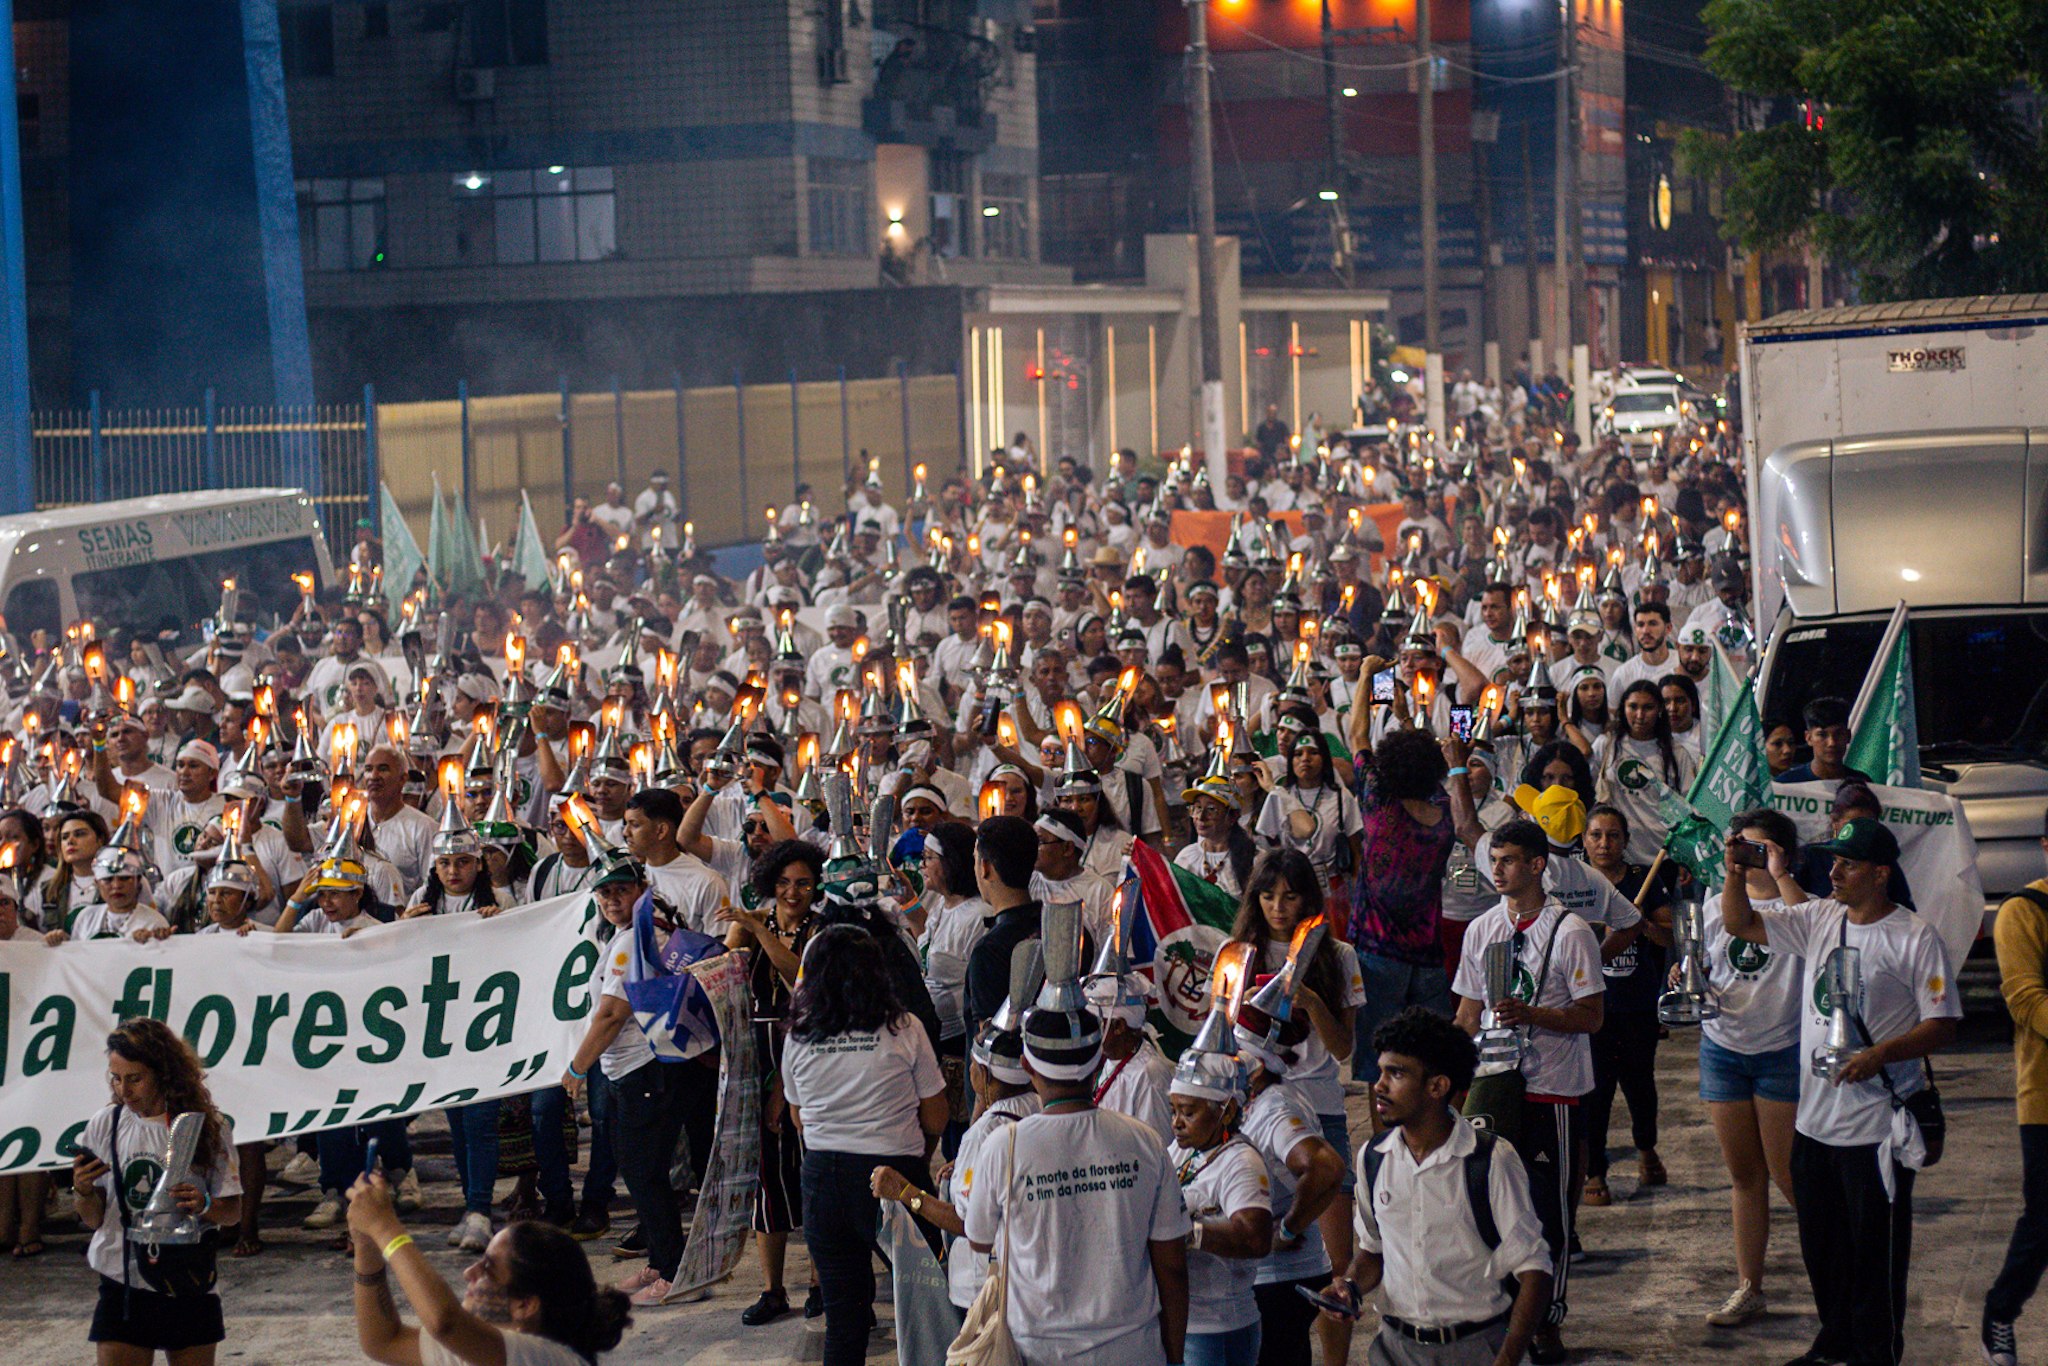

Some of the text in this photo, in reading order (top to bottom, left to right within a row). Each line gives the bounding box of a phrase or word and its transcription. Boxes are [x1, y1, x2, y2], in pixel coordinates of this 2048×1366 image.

[1890, 350, 1961, 362] THORCK
[78, 520, 153, 554] SEMAS
[1774, 795, 1819, 814] TIVO
[1878, 807, 1955, 826] VENTUDE
[552, 897, 600, 1021] é
[1036, 1170, 1069, 1186] morte
[1072, 1166, 1087, 1180] da
[1089, 1161, 1131, 1177] floresta
[1132, 1159, 1140, 1173] é
[1027, 1191, 1034, 1202] o
[1037, 1188, 1055, 1201] fim
[1058, 1183, 1072, 1197] da
[1075, 1180, 1107, 1194] nossa
